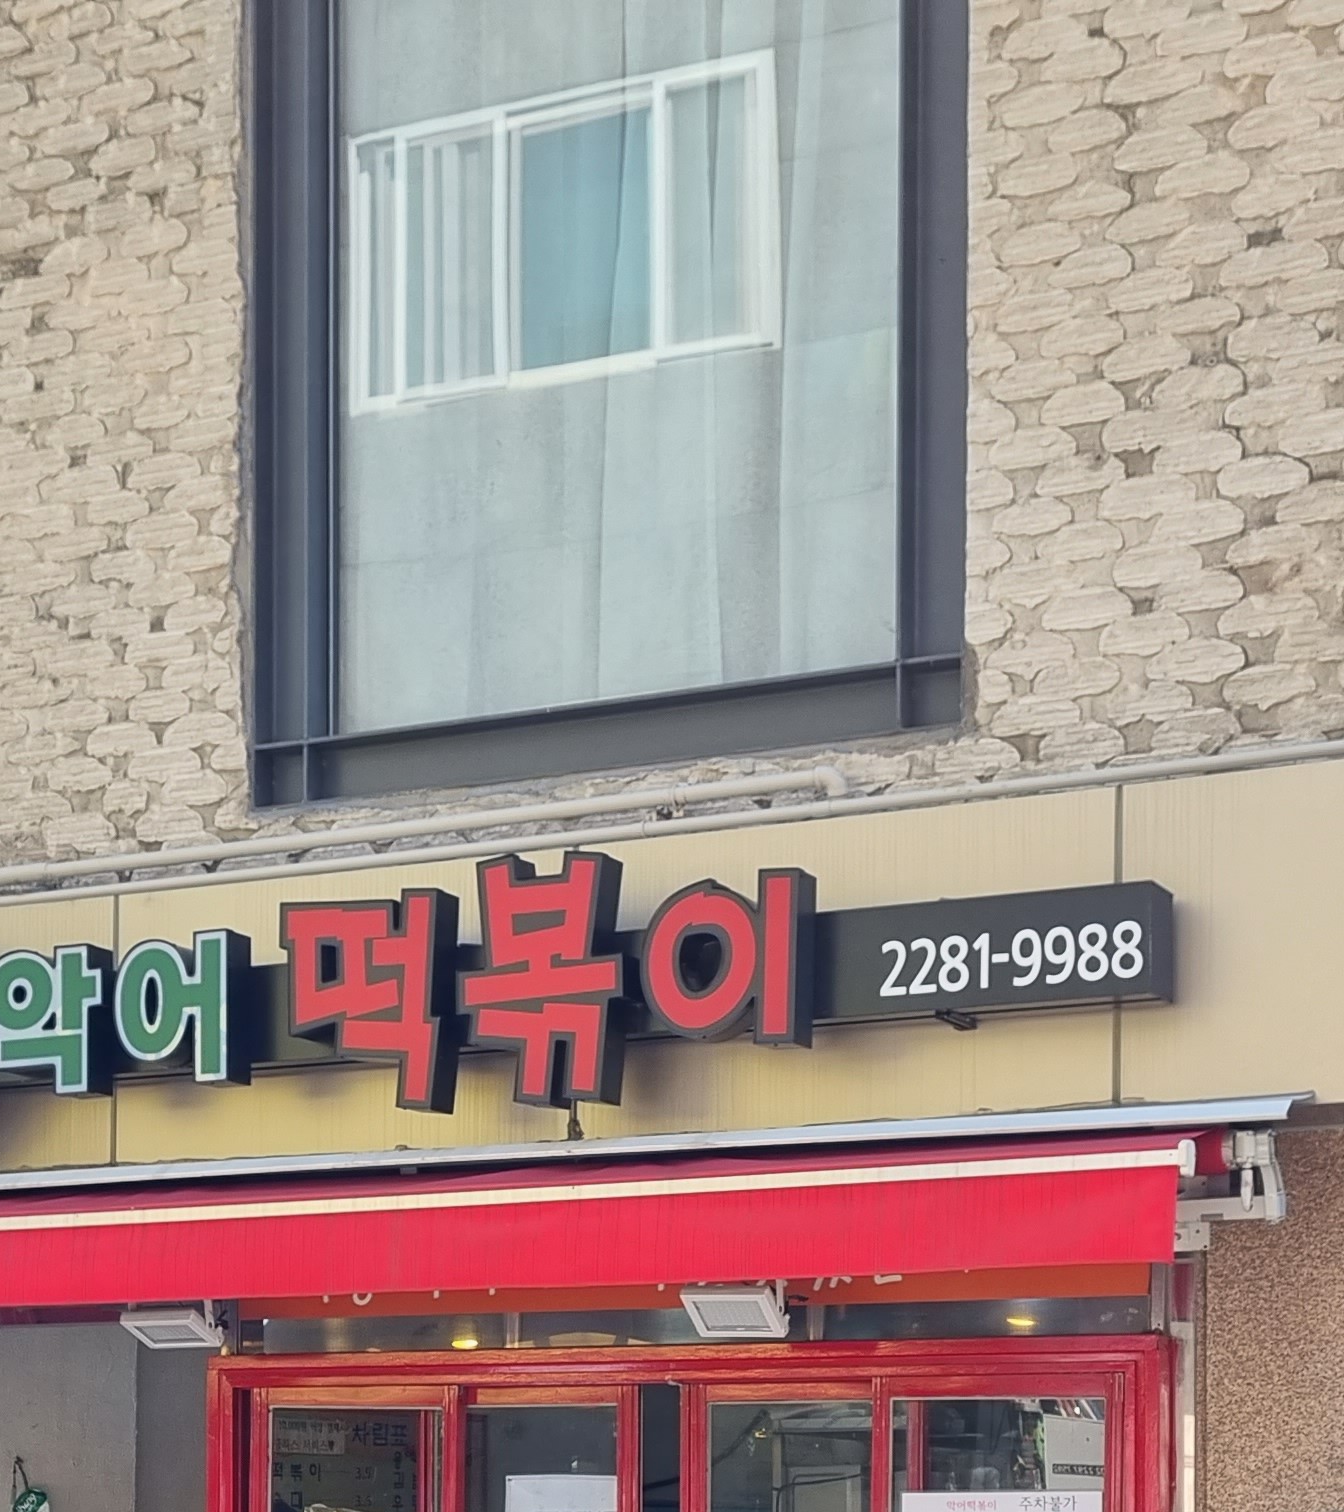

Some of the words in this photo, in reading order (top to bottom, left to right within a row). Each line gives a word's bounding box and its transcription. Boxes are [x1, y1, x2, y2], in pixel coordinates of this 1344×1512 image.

[281, 851, 801, 1109] 떡볶이
[878, 917, 1146, 998] 2281-9988
[351, 1422, 408, 1447] 차림표
[946, 1499, 997, 1512] 악어떡볶이
[1018, 1495, 1078, 1512] 주차불가
